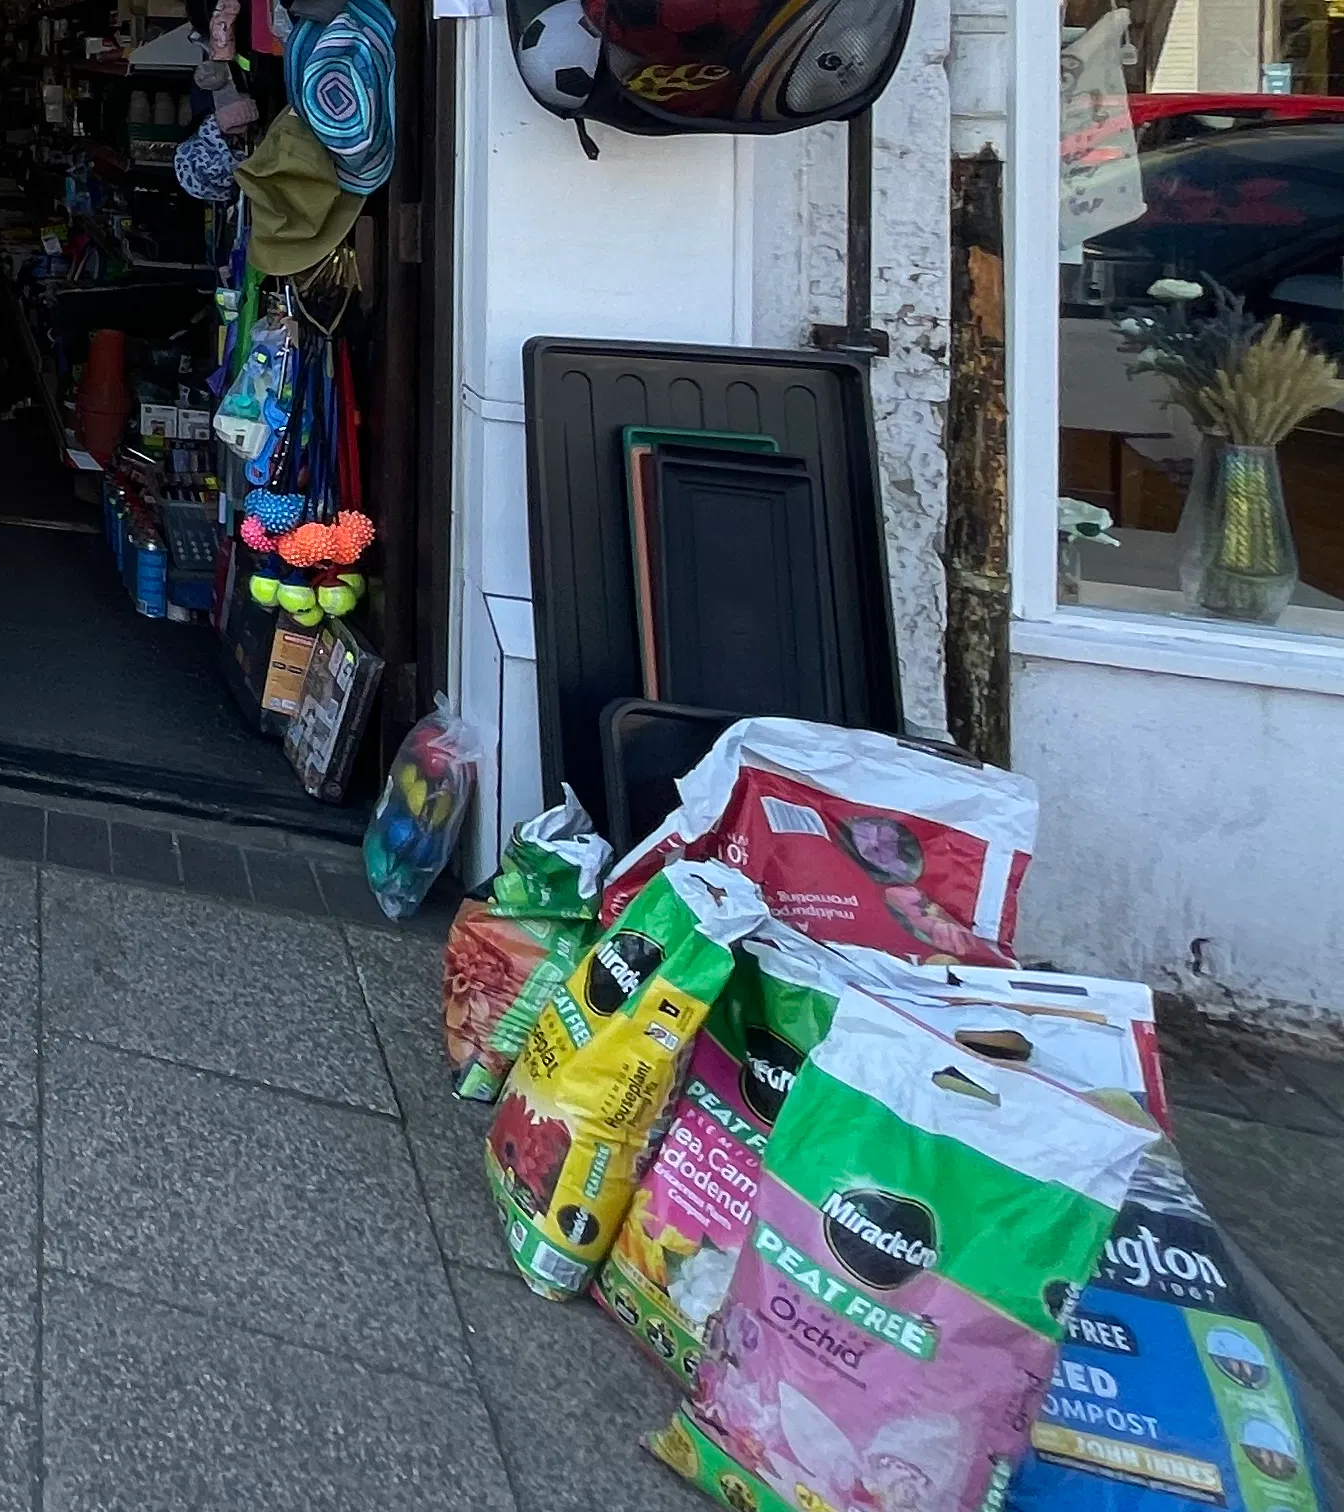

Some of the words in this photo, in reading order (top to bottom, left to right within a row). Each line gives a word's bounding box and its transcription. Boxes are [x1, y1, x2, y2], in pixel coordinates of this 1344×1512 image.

[776, 889, 860, 908] promoting
[604, 1060, 653, 1130] Houseplant
[685, 1079, 751, 1135] PEAT
[755, 1226, 848, 1303] PEAT
[844, 1295, 928, 1356] FREE
[769, 1294, 864, 1370] Orchid
[1075, 1435, 1143, 1469] JOHN
[1145, 1451, 1219, 1488] INNES
